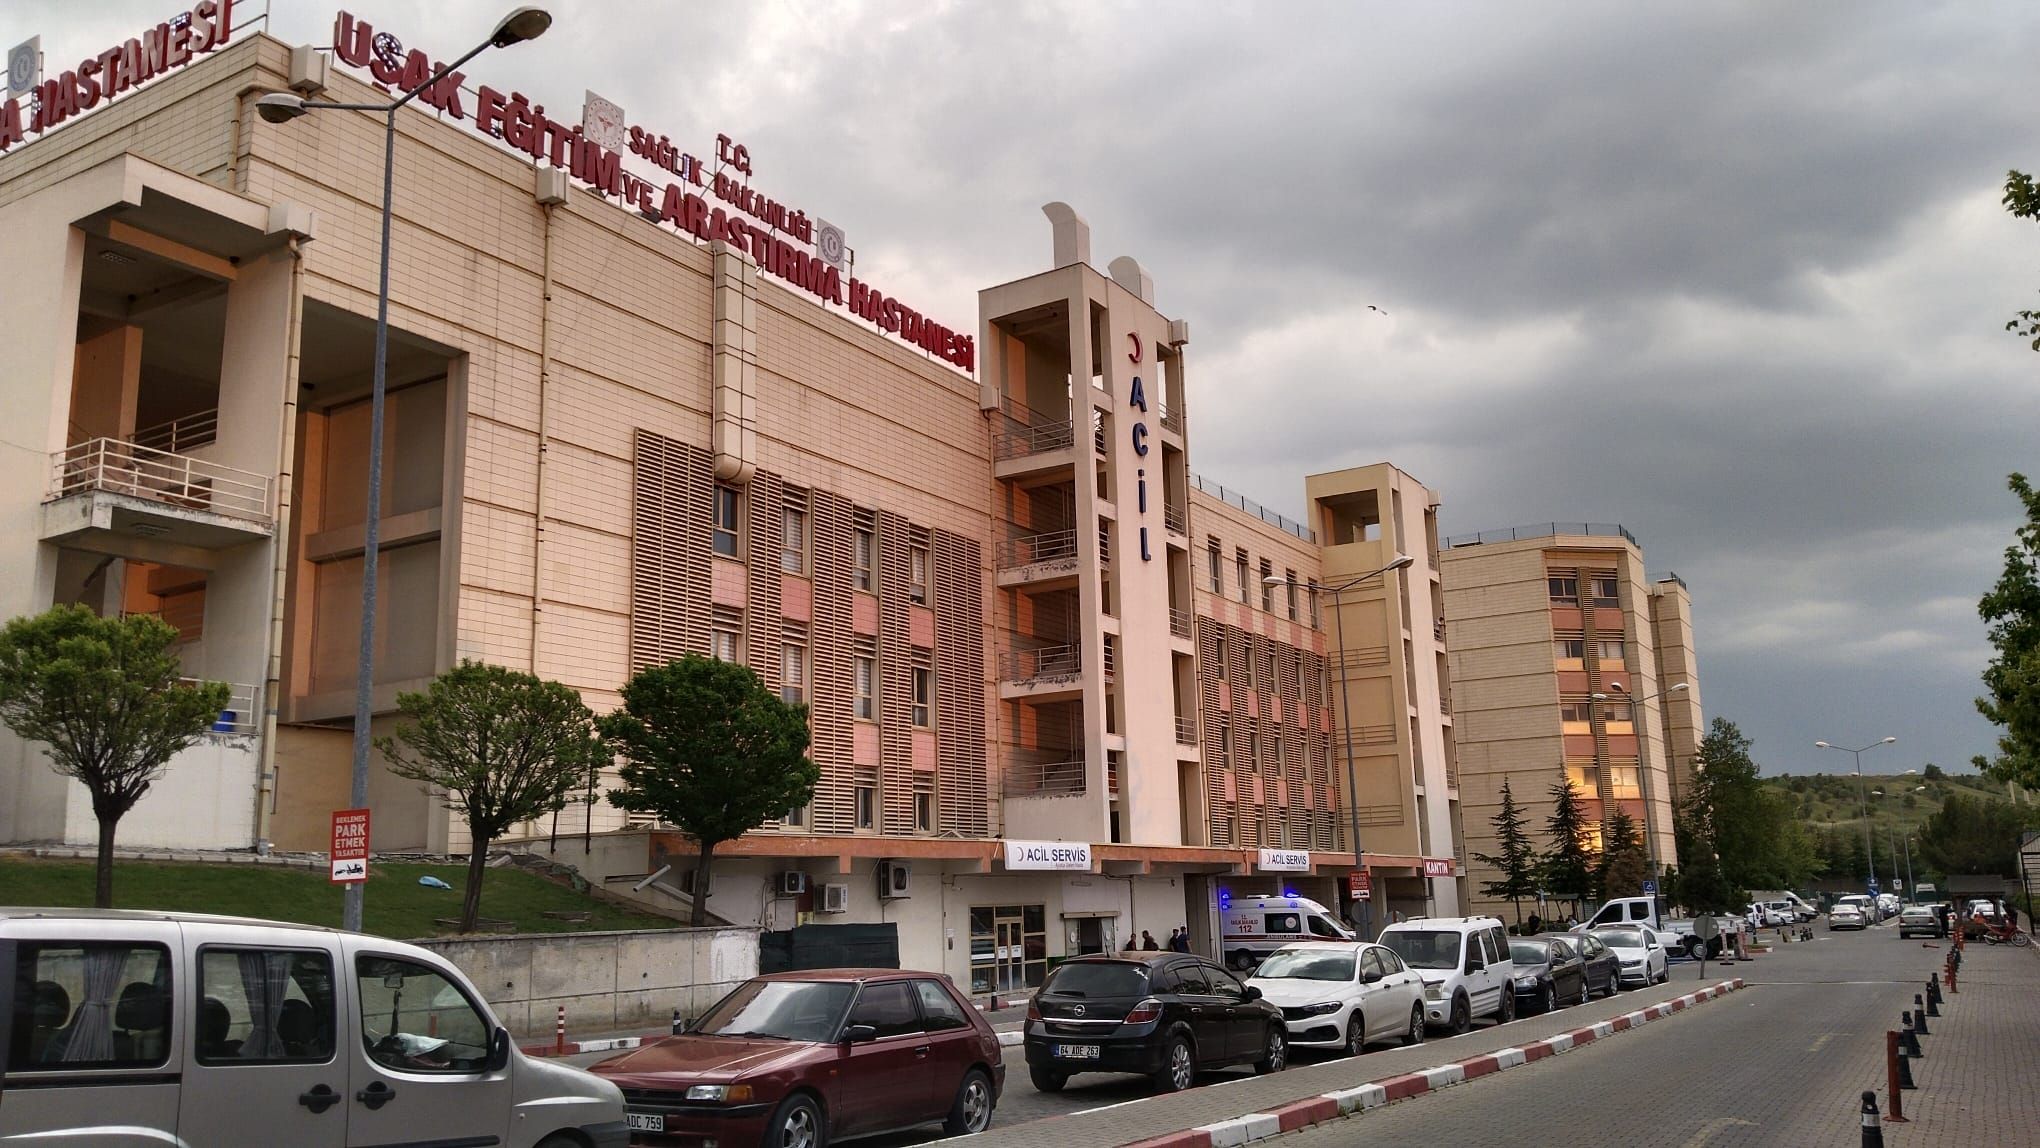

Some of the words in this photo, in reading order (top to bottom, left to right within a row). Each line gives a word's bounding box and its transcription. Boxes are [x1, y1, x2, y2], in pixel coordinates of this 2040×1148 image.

[718, 133, 752, 176] T.C.
[629, 125, 703, 187] SAĞLIK
[714, 171, 812, 245] BAKANLIĞI
[475, 85, 621, 197] EĞİTİM
[622, 173, 654, 214] VE
[849, 277, 975, 373] HASTANESİ
[1129, 376, 1152, 562] ACİL
[335, 823, 367, 838] PARK
[335, 837, 365, 849] ETMEK
[1026, 846, 1049, 862] ACİL
[1052, 846, 1086, 862] SERVİS
[1286, 853, 1307, 865] SERVİS
[1238, 924, 1253, 934] 112
[1060, 1045, 1069, 1055] 64
[1087, 1046, 1099, 1056] 263
[645, 1116, 662, 1130] 759
